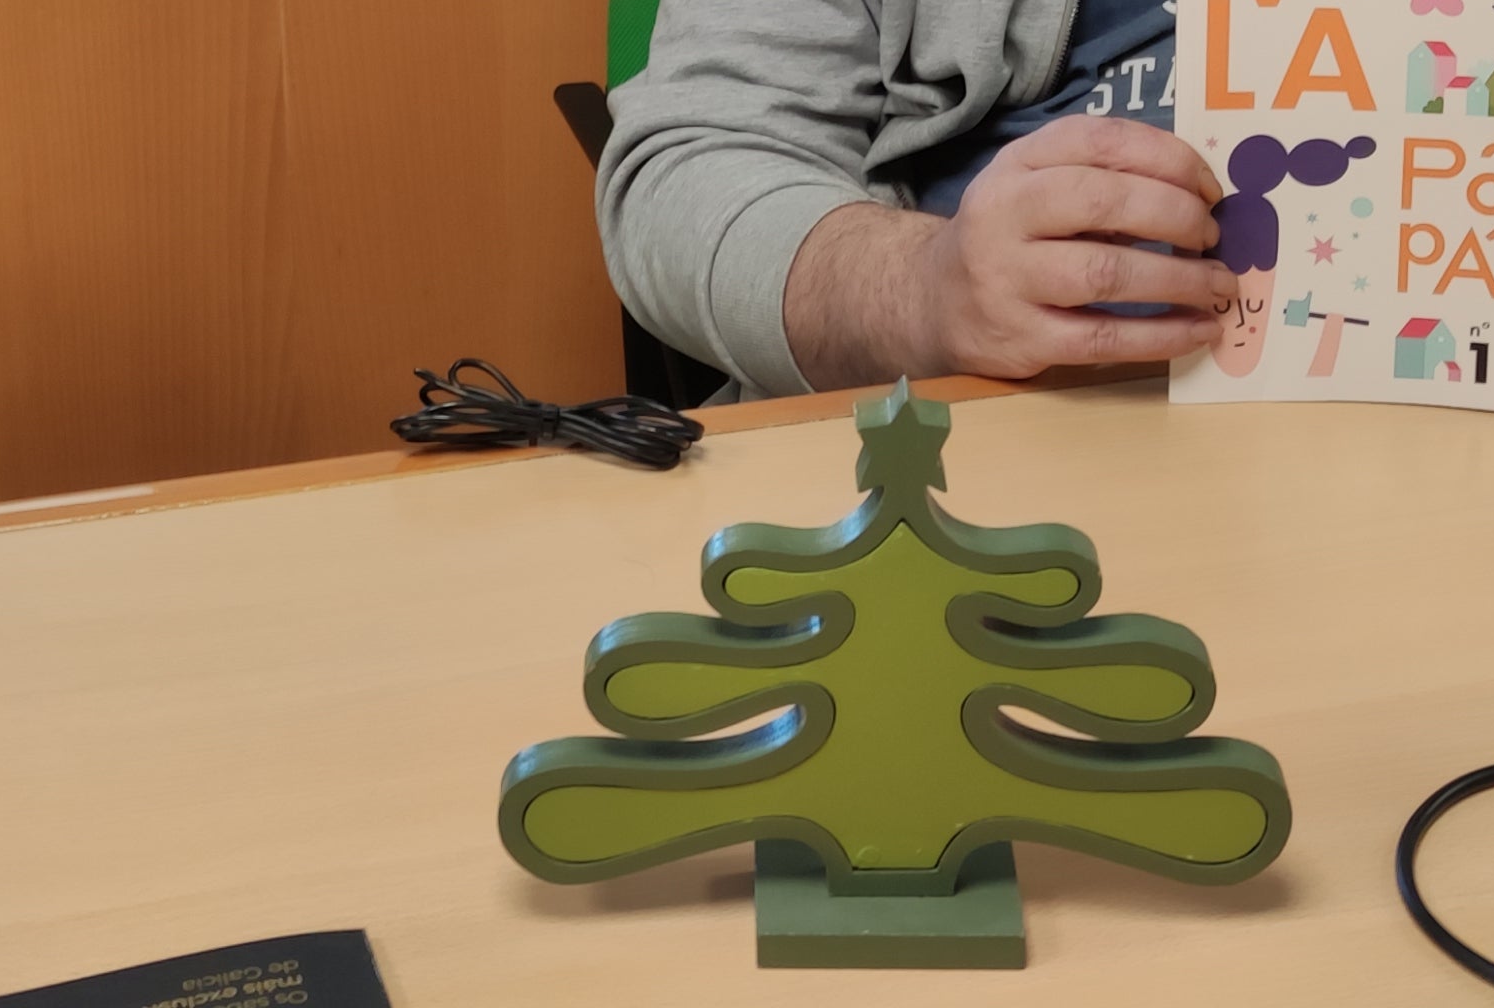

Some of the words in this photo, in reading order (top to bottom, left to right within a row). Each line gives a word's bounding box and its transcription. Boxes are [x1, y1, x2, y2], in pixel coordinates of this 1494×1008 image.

[1086, 57, 1176, 116] ST
[1469, 342, 1489, 384] 1
[181, 966, 263, 991] Galicia
[267, 959, 300, 974] de
